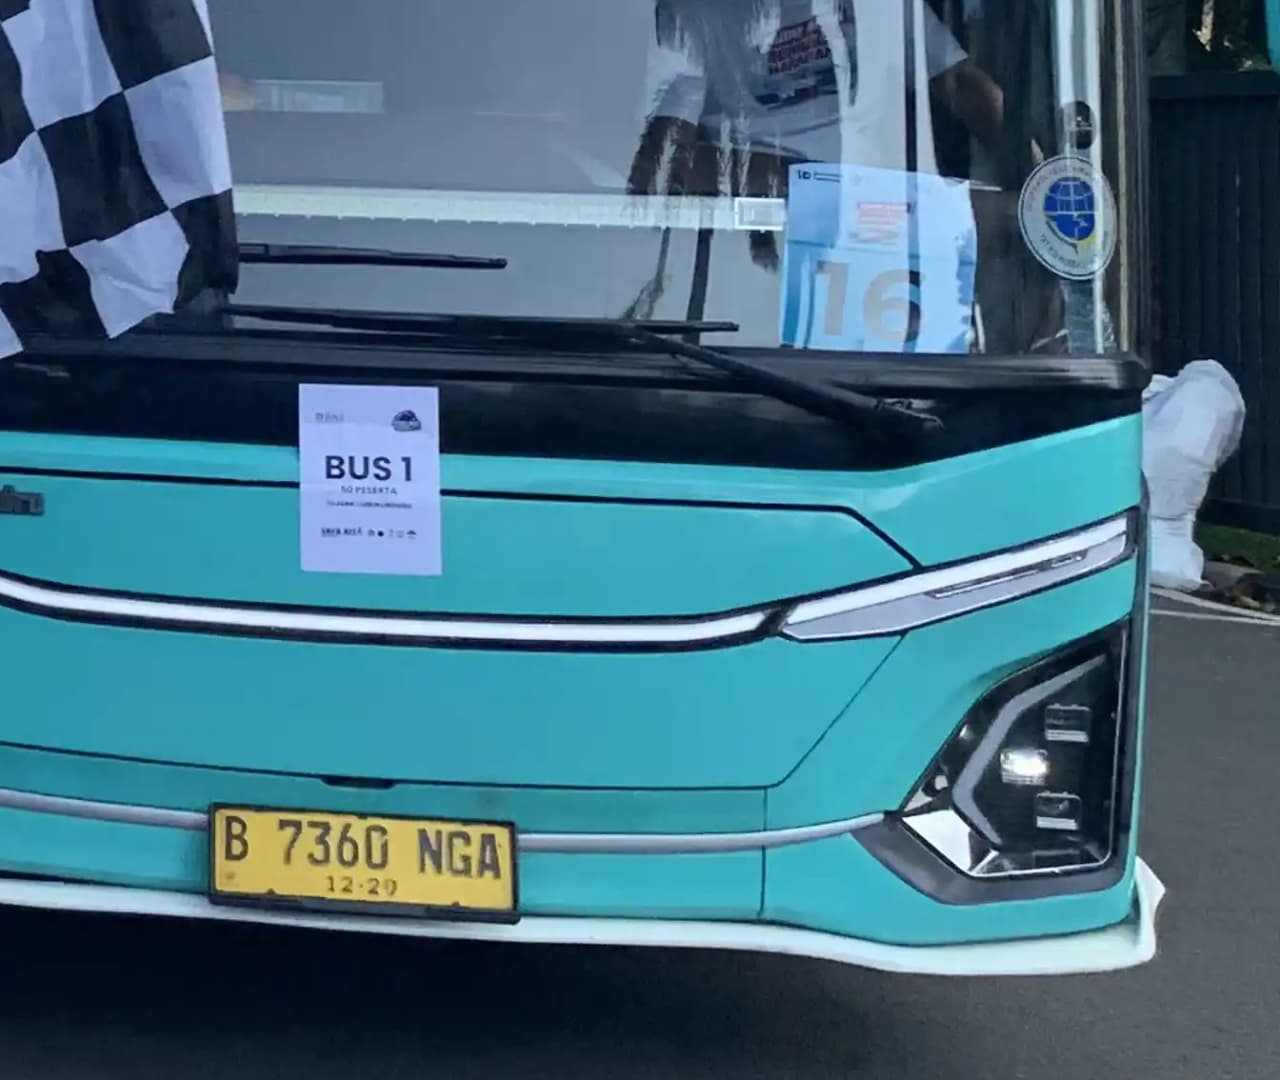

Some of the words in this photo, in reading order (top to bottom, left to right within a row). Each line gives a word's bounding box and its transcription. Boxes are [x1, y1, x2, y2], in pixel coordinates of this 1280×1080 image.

[816, 261, 922, 342] 16
[325, 455, 392, 481] BUS
[401, 456, 412, 481] 1
[224, 815, 249, 861] B
[278, 819, 389, 871] 7360
[417, 828, 502, 880] NGA
